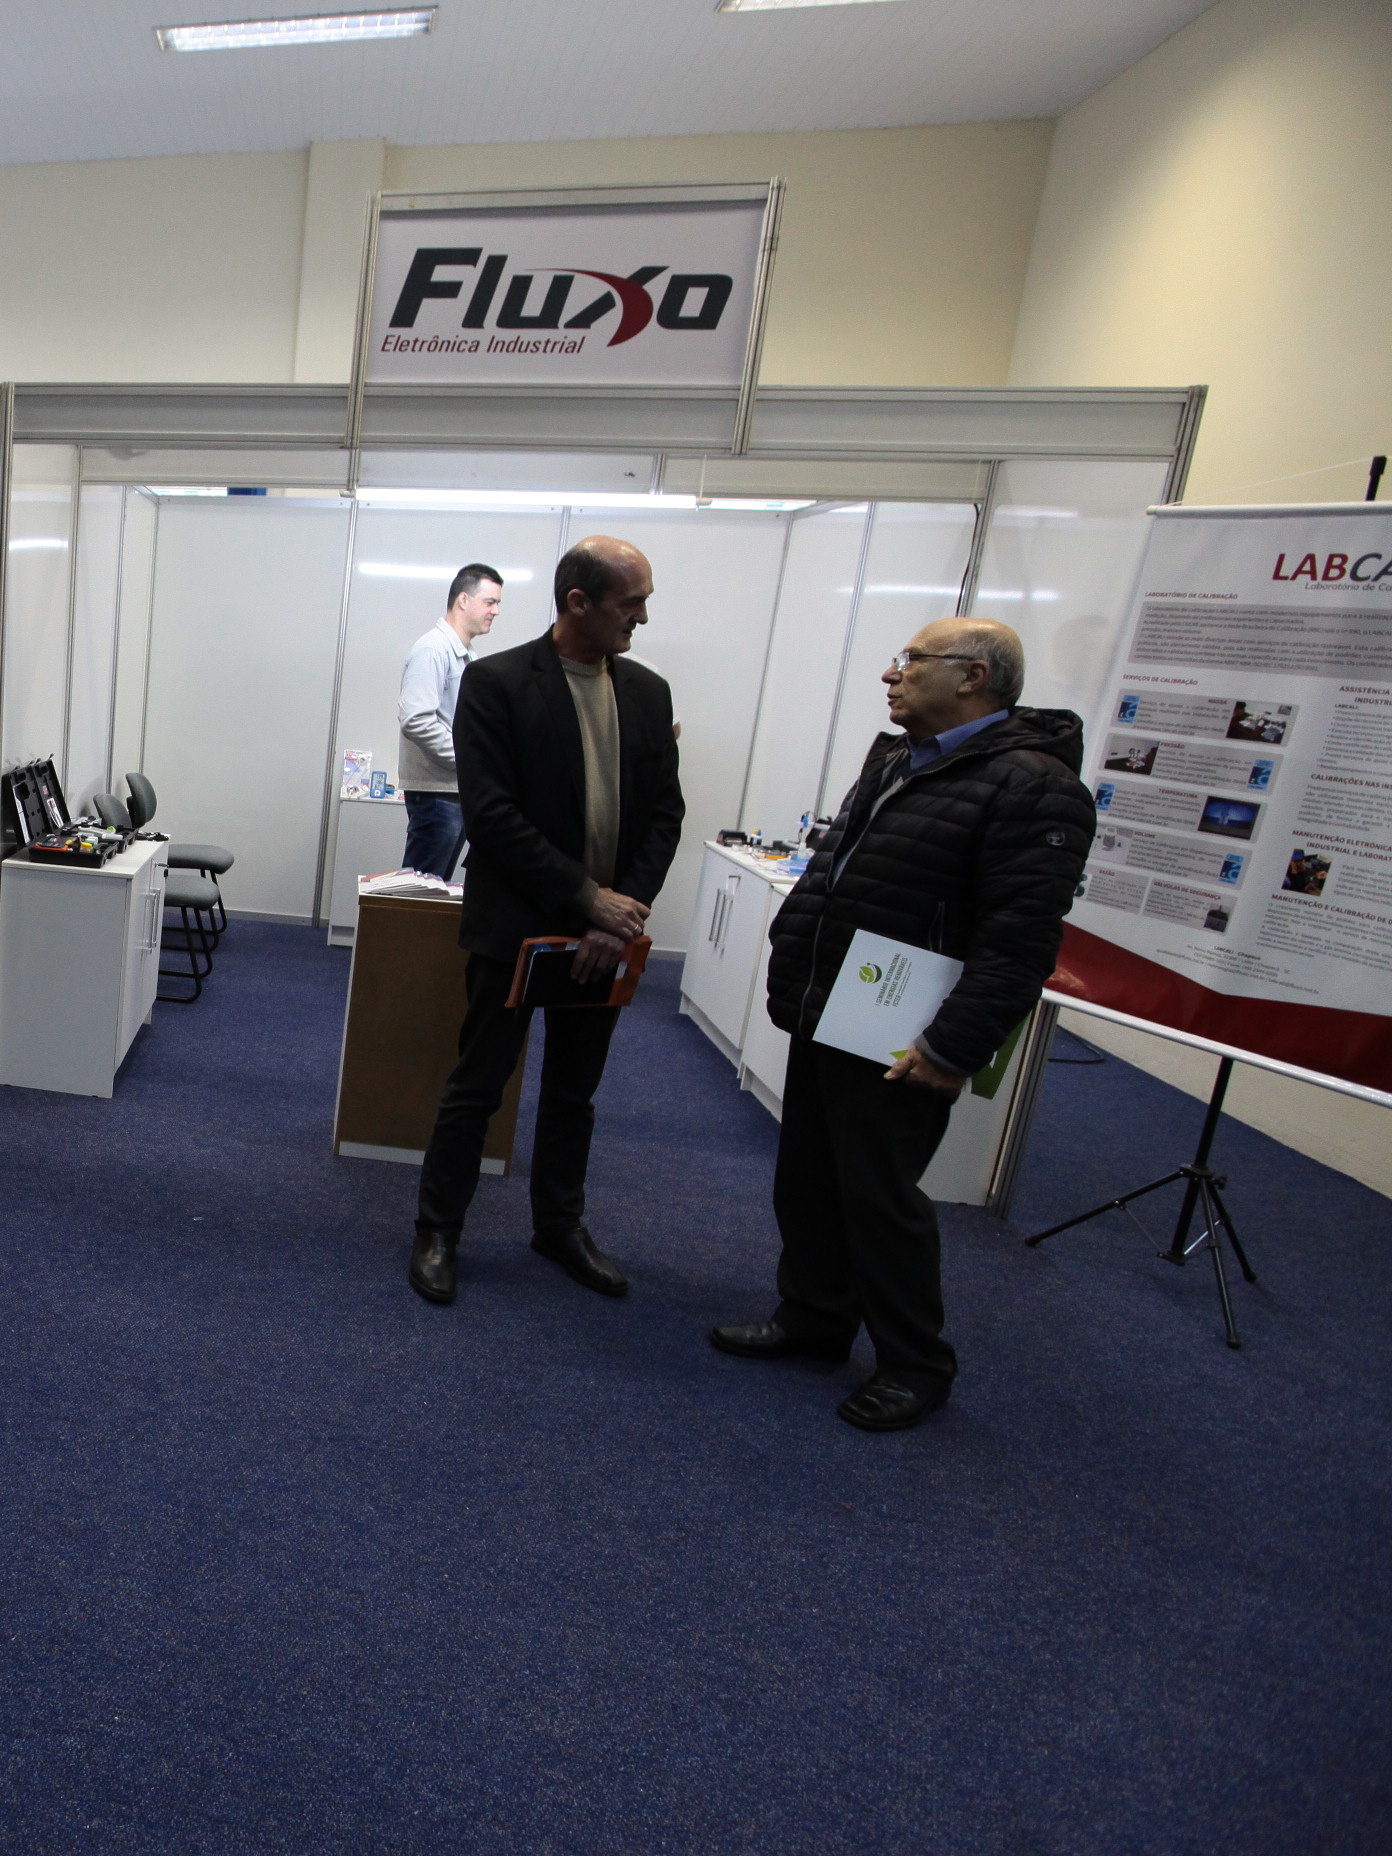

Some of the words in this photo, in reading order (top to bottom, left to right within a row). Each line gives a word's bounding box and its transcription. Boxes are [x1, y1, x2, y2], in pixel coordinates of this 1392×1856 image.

[388, 247, 734, 347] Fluxo
[380, 334, 480, 354] Eletrônica
[486, 335, 586, 355] Industrial
[1305, 582, 1360, 591] Laboratório
[1362, 583, 1375, 591] de
